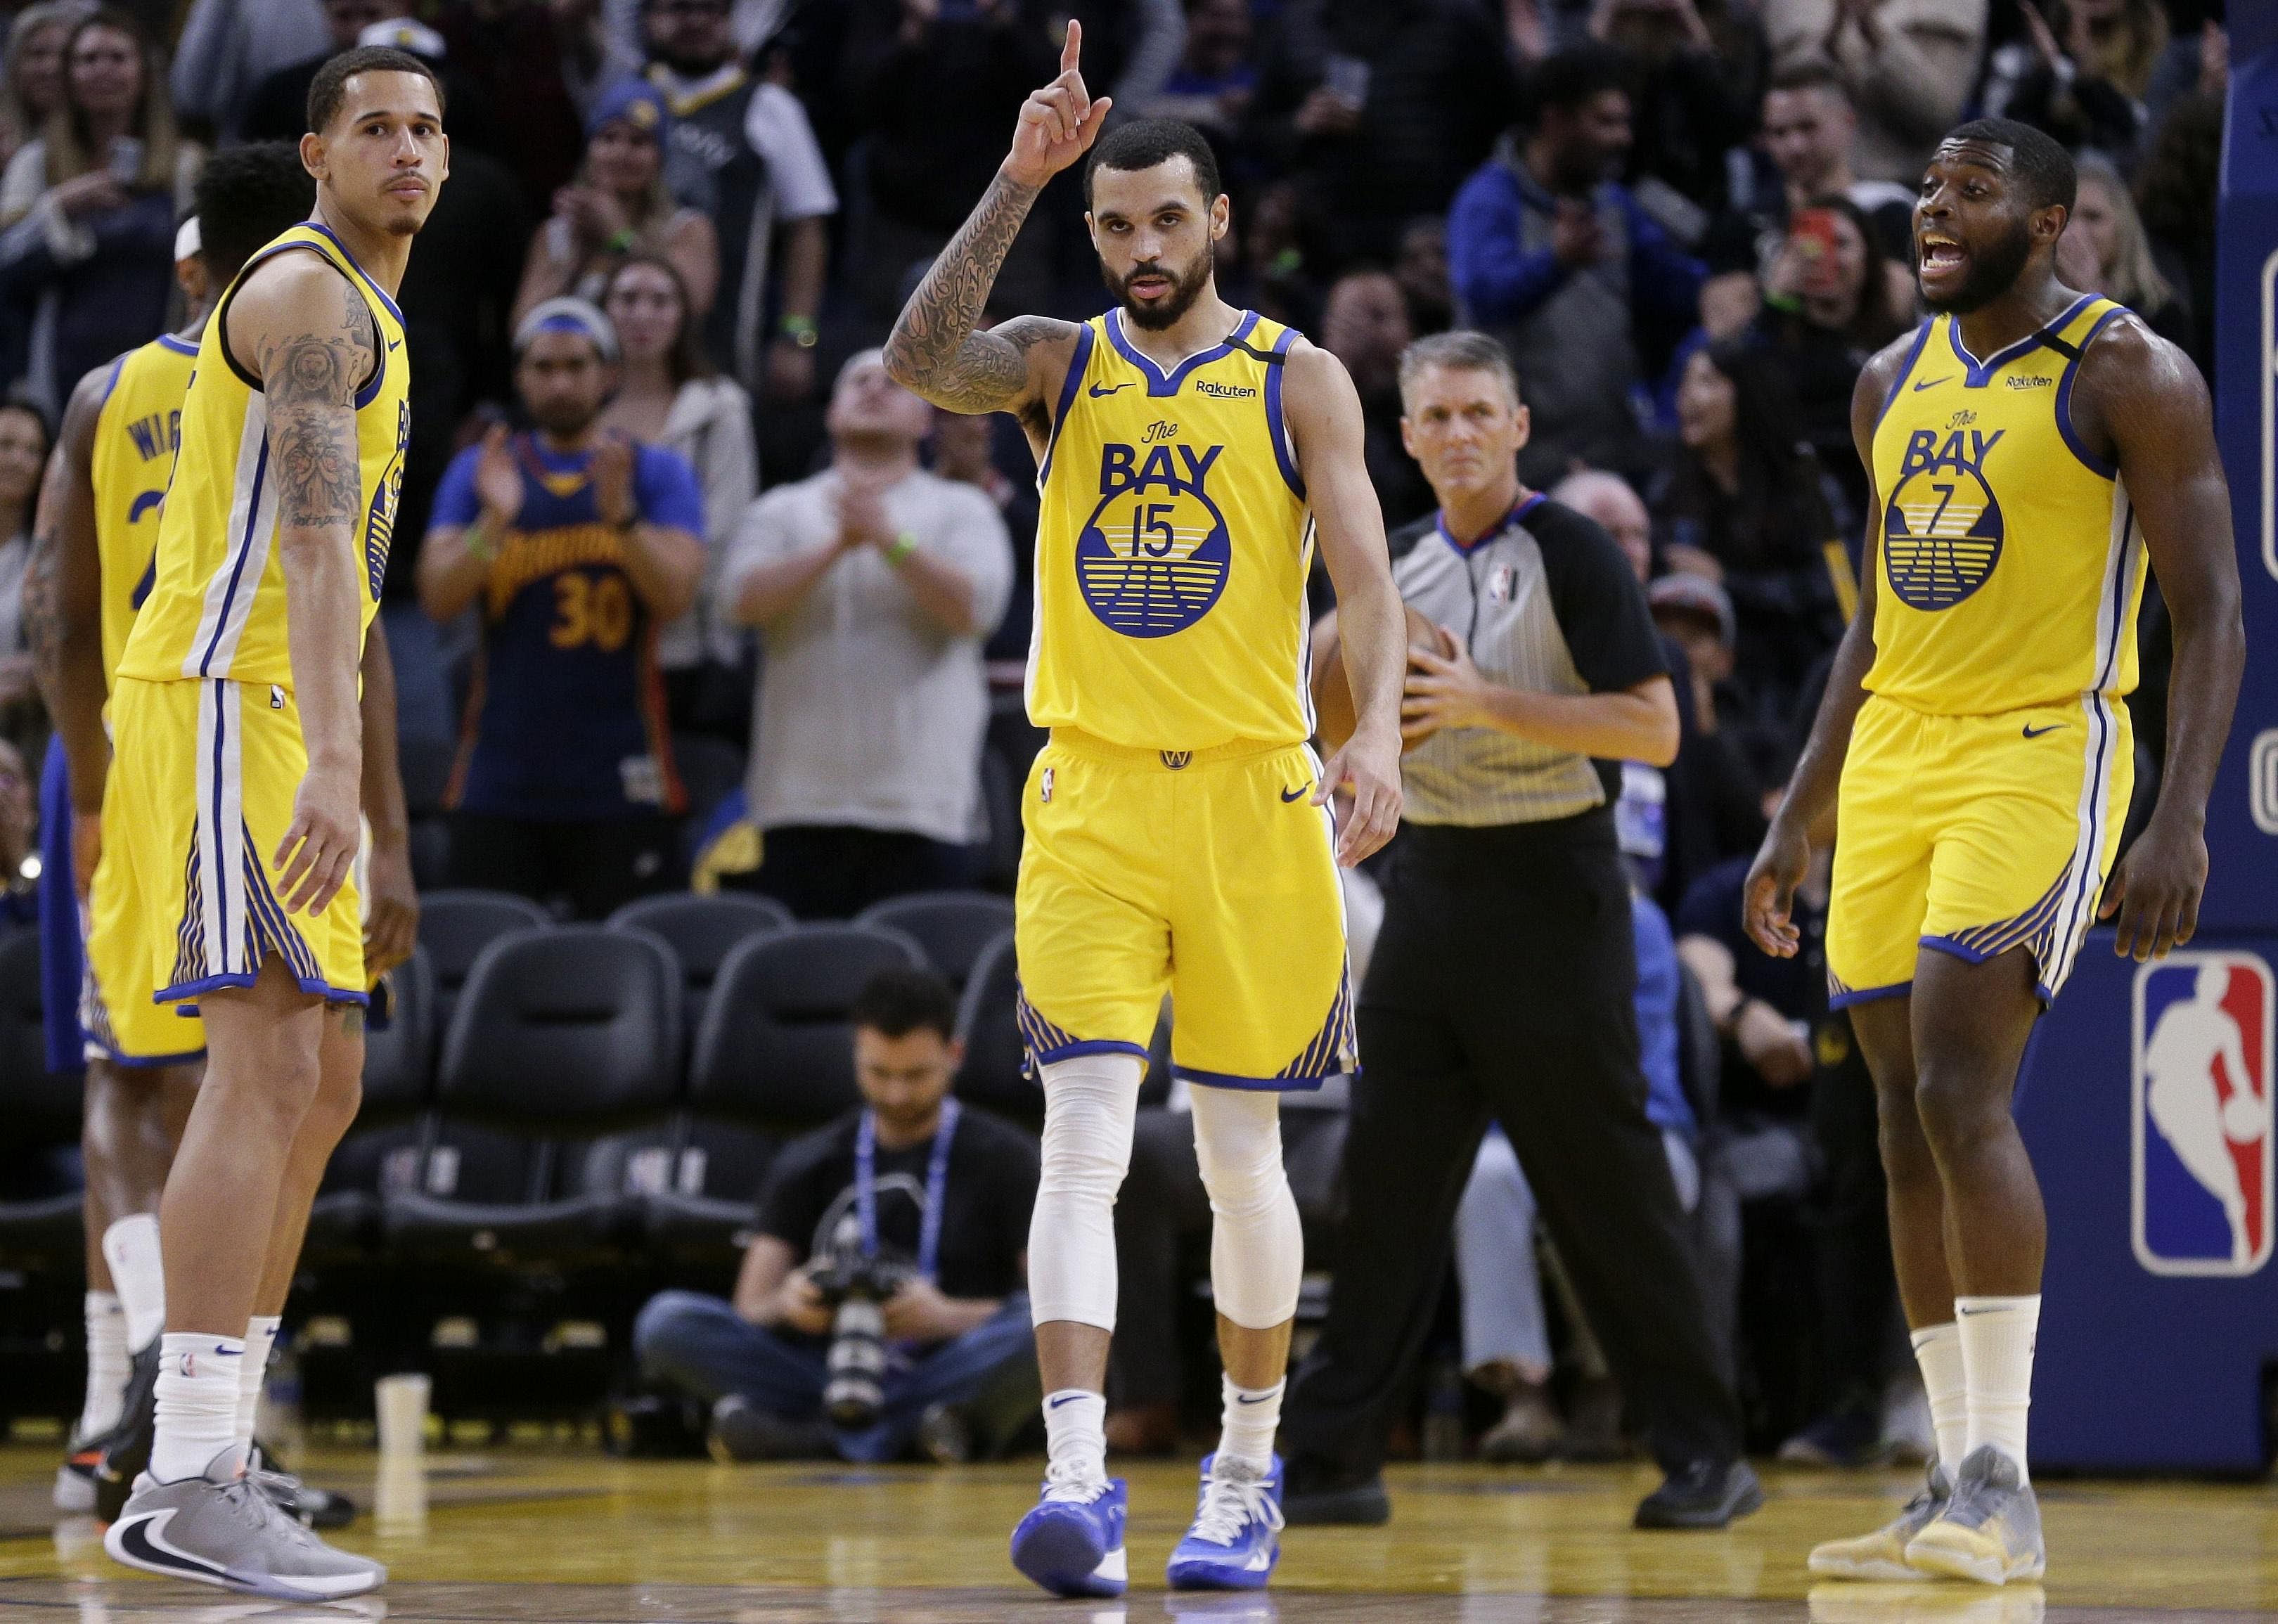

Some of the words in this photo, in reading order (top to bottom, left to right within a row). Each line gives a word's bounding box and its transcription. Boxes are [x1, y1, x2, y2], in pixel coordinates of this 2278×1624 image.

[1196, 380, 1256, 398] Rakuten
[1141, 420, 1178, 444] The
[1946, 409, 1977, 430] The
[1100, 443, 1225, 496] BAY
[1900, 430, 2006, 476] BAY
[1131, 503, 1176, 558] 15
[1926, 484, 1955, 535] 7
[549, 572, 631, 652] 30
